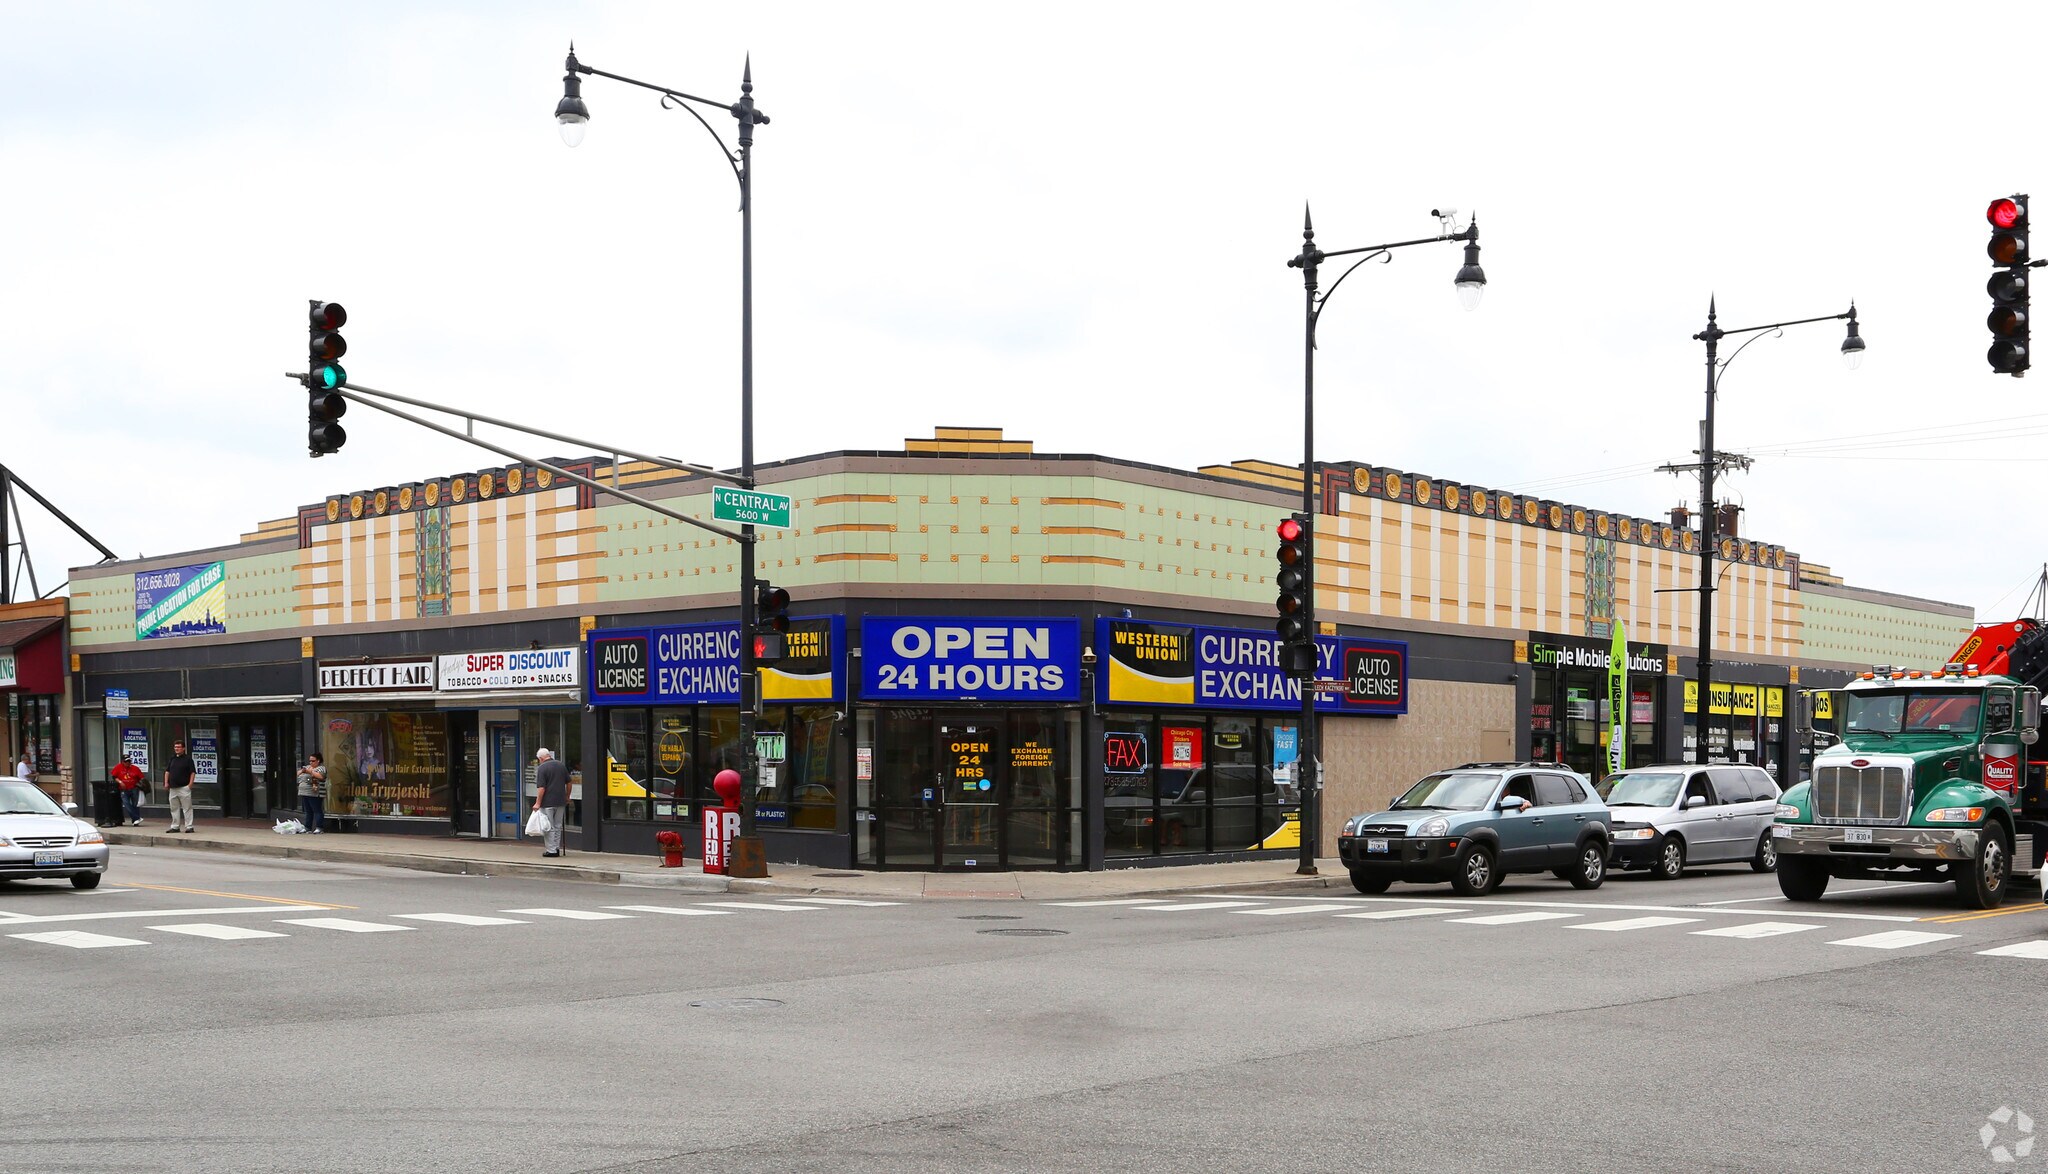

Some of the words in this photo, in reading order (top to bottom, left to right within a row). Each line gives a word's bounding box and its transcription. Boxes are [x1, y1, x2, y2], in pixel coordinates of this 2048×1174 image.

[715, 493, 721, 502] N
[724, 493, 777, 511] CENTRAL
[779, 502, 789, 511] AV
[736, 509, 758, 520] 5600
[762, 513, 769, 521] W
[136, 572, 180, 591] 312.656.3028
[137, 609, 157, 635] PRIME
[157, 587, 188, 620] LOCATION
[187, 578, 201, 599] FOR
[201, 564, 222, 590] LEASE
[658, 629, 741, 662] CURRENC
[786, 631, 818, 645] TERN
[891, 626, 1049, 659] OPEN
[1115, 631, 1178, 648] WESTERN
[604, 643, 638, 664] AUTO
[788, 645, 818, 657] NION
[1136, 646, 1178, 661] UNION
[1533, 643, 1574, 669] Simple
[1576, 647, 1611, 669] Mobile
[1627, 651, 1662, 672] lutions
[467, 654, 504, 672] SUPER
[509, 651, 571, 670] DISCOUNT
[1357, 658, 1390, 676] AUTO
[321, 667, 387, 687] PERFECT
[392, 665, 432, 685] HAIR
[447, 677, 481, 687] TOBACCO
[489, 676, 509, 685] COLD
[511, 675, 527, 684] POP
[538, 673, 572, 683] SNACKS
[598, 667, 645, 689] LICENSE
[658, 664, 740, 695] EXCHANG
[878, 664, 918, 690] 24
[929, 664, 1064, 691] HOURS
[951, 743, 989, 752] OPEN
[1107, 739, 1140, 766] FAX
[1276, 740, 1294, 749] FAST
[386, 764, 393, 773] Do
[395, 764, 409, 773] Hair
[959, 755, 980, 765] 24
[956, 768, 984, 777] HRS
[1987, 764, 2014, 777] QUALITY
[705, 839, 718, 854] ED
[705, 855, 718, 866] EYE
